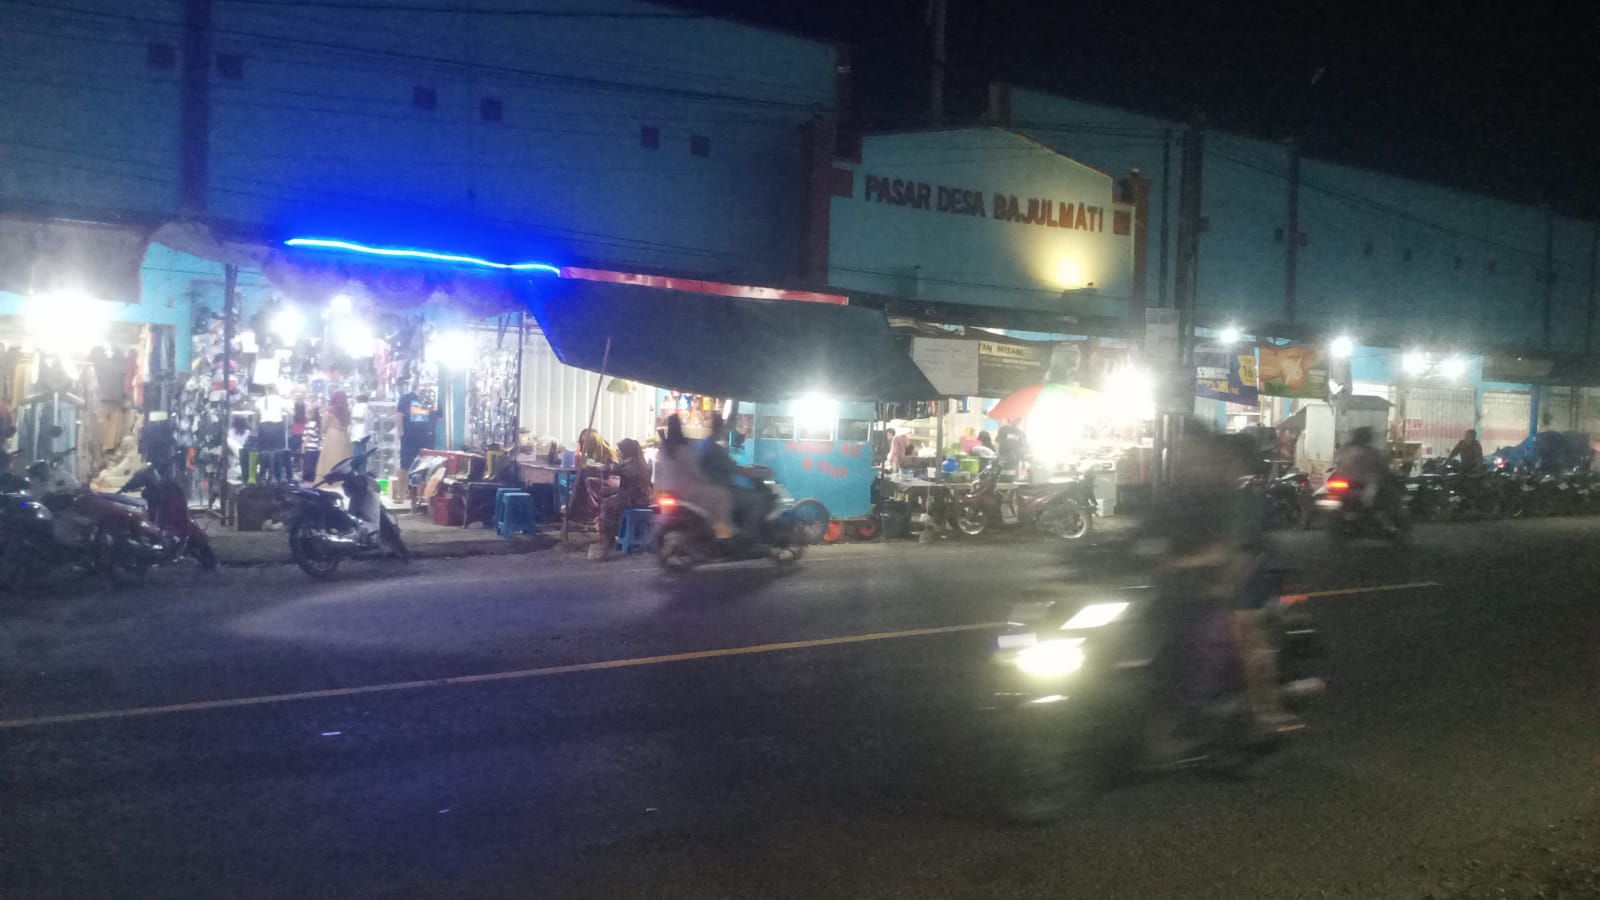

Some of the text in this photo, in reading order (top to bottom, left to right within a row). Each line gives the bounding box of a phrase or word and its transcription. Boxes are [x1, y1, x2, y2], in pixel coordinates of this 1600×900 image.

[865, 174, 1104, 233] PASAR DESA BAJULMATI
